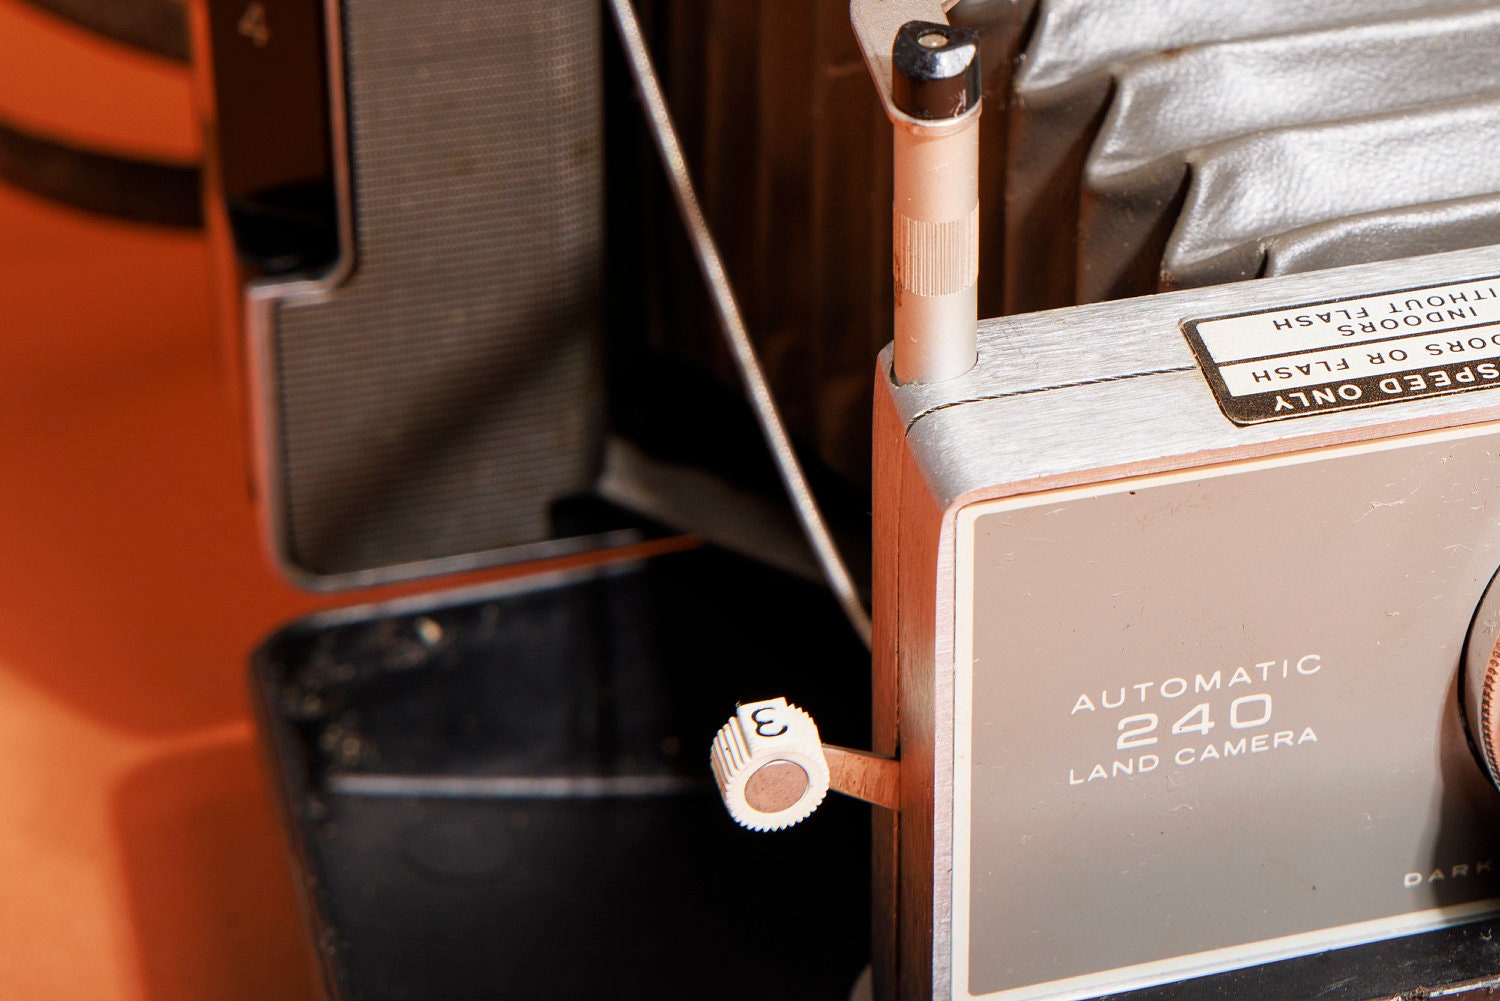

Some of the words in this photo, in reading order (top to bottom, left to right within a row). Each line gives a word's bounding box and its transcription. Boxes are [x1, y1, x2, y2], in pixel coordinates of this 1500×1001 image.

[1272, 307, 1368, 331] FLASH
[1337, 305, 1477, 337] INDOORS
[1252, 355, 1348, 383] FLASH
[1367, 345, 1408, 364] OR
[1379, 361, 1500, 395] SPEED
[1274, 381, 1361, 412] ONLY
[1070, 654, 1322, 716] AUTOMATIC
[1116, 694, 1272, 750] 240
[1069, 754, 1159, 786] LAND
[1174, 727, 1318, 766] CAMERA
